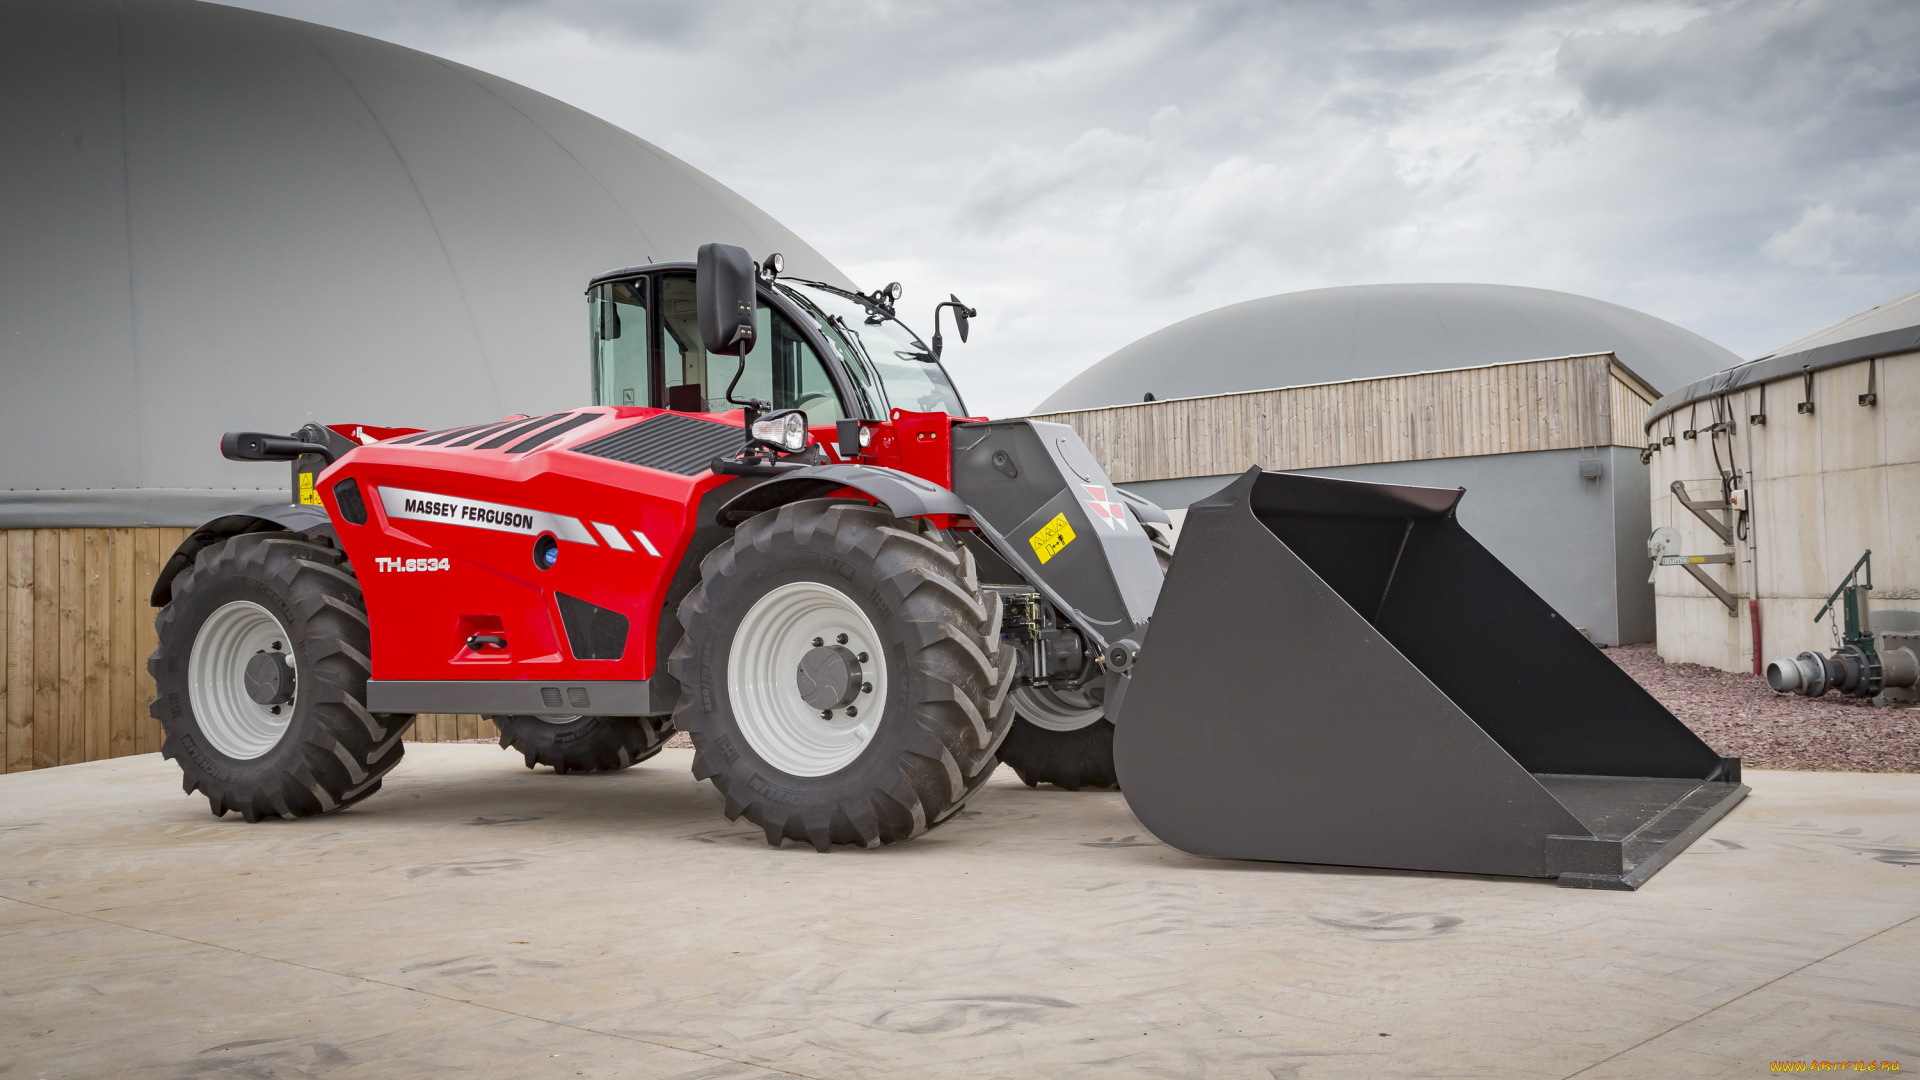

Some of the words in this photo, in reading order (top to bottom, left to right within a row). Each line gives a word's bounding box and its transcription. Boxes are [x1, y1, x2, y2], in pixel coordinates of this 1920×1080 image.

[404, 498, 457, 518] MASSEY
[461, 505, 533, 530] FERGUSON
[375, 557, 450, 573] TH.6534
